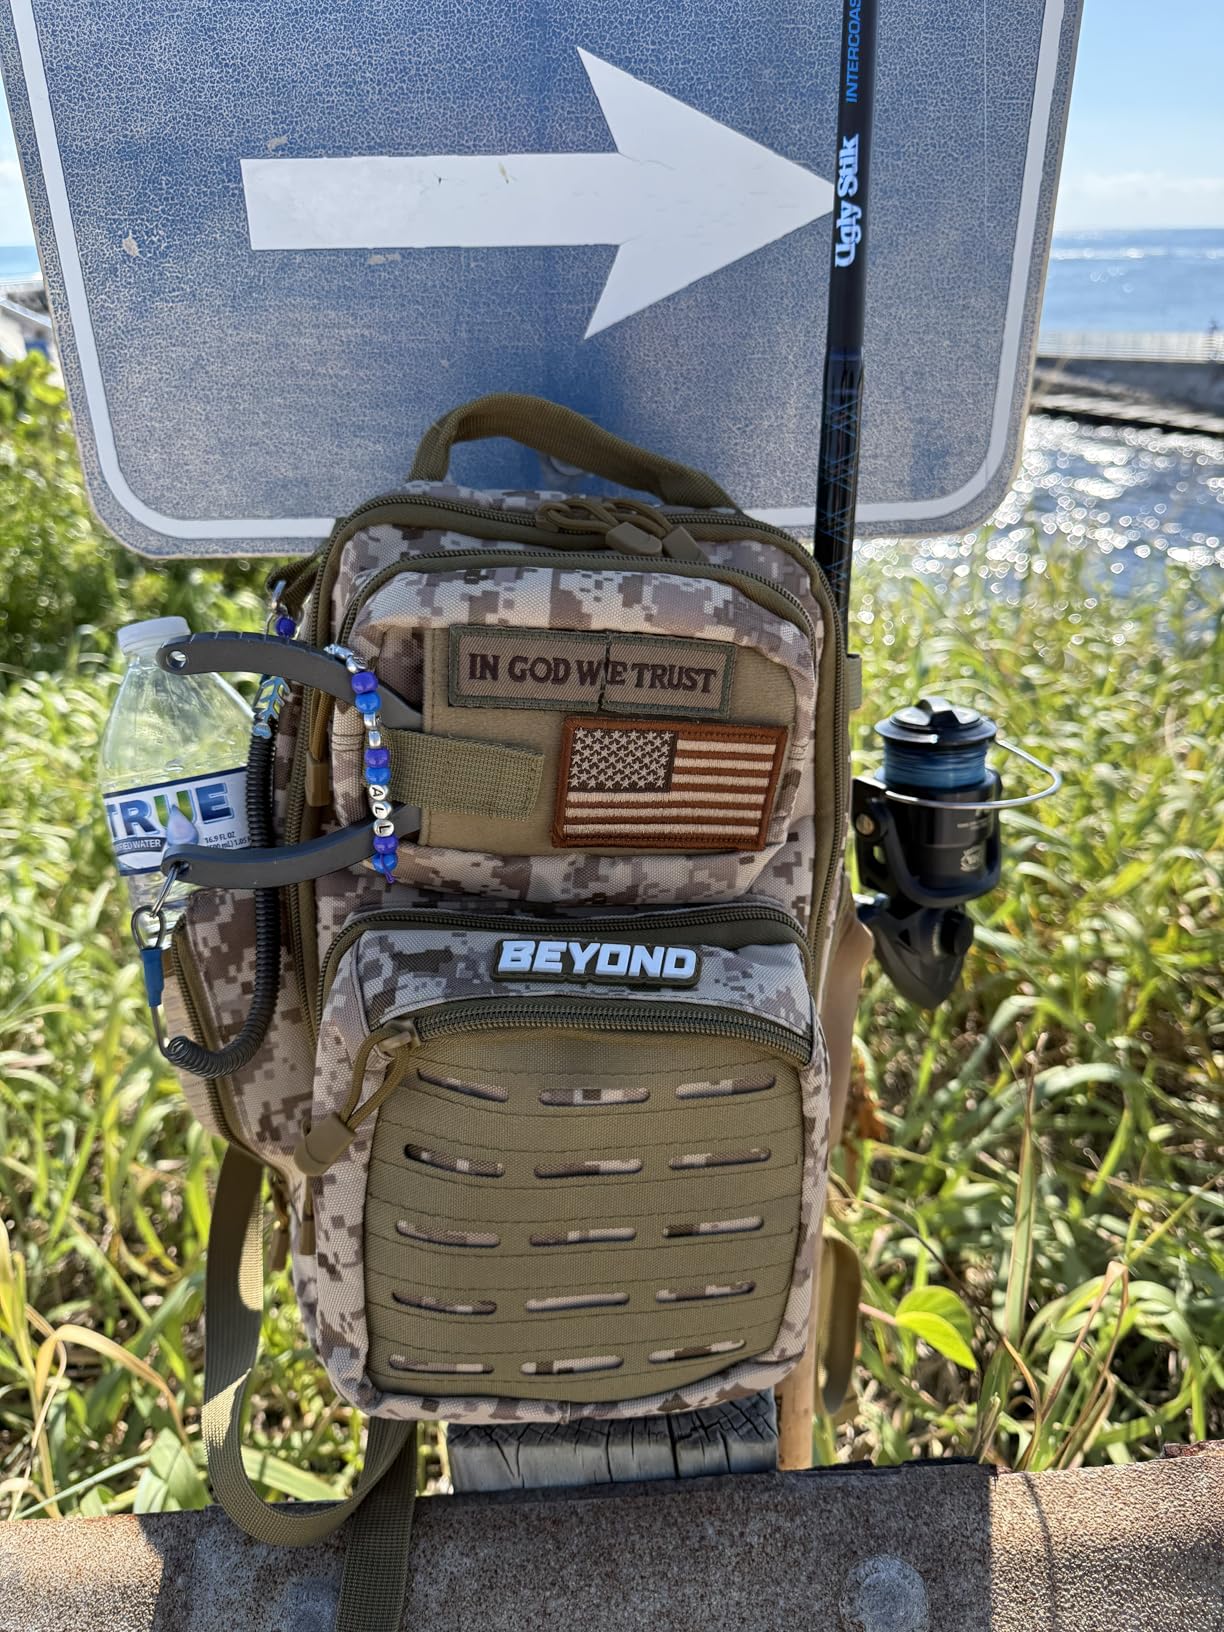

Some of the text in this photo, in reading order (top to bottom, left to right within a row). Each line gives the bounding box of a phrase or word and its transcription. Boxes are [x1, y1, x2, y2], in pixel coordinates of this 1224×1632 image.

[834, 200, 862, 268] Ugly
[468, 653, 717, 693] IN GOD WE TRUST
[105, 782, 234, 838] TRUE
[132, 839, 161, 849] WATER
[204, 834, 219, 843] 16.9
[498, 940, 697, 979] BEYOND
